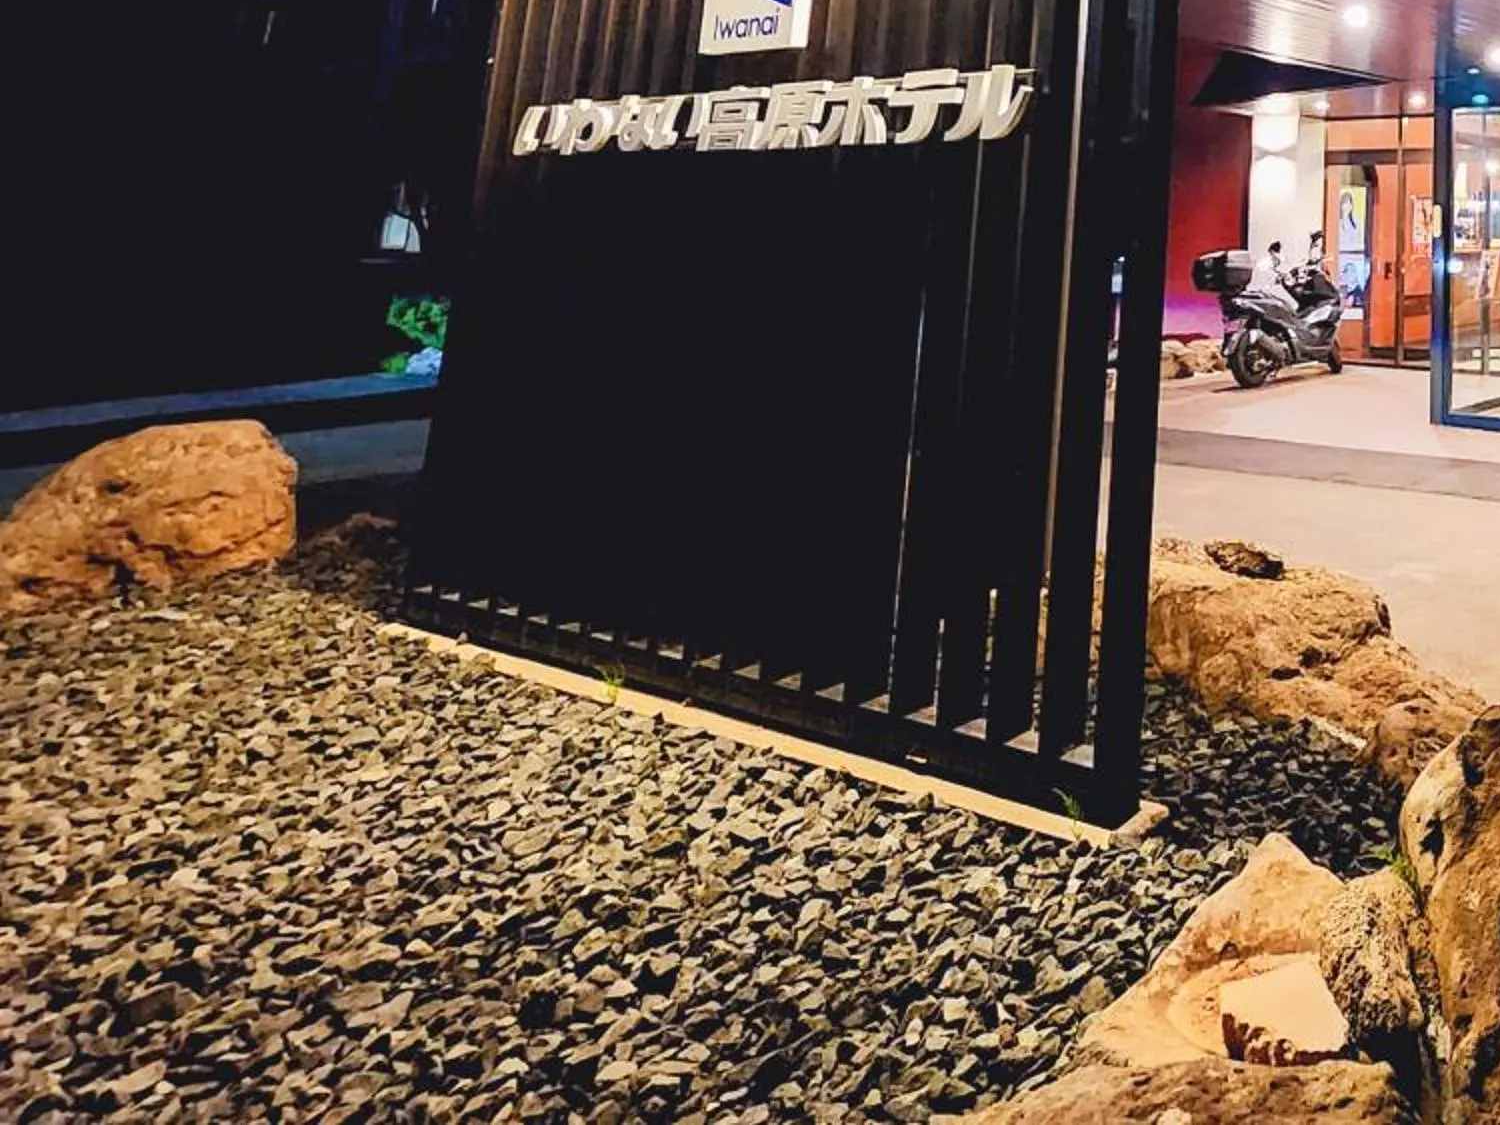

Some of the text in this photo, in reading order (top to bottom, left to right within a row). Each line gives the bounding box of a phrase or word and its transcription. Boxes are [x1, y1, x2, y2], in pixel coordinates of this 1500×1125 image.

[713, 7, 780, 40] Iwanai
[512, 64, 1034, 156] いわない高原ホテル
